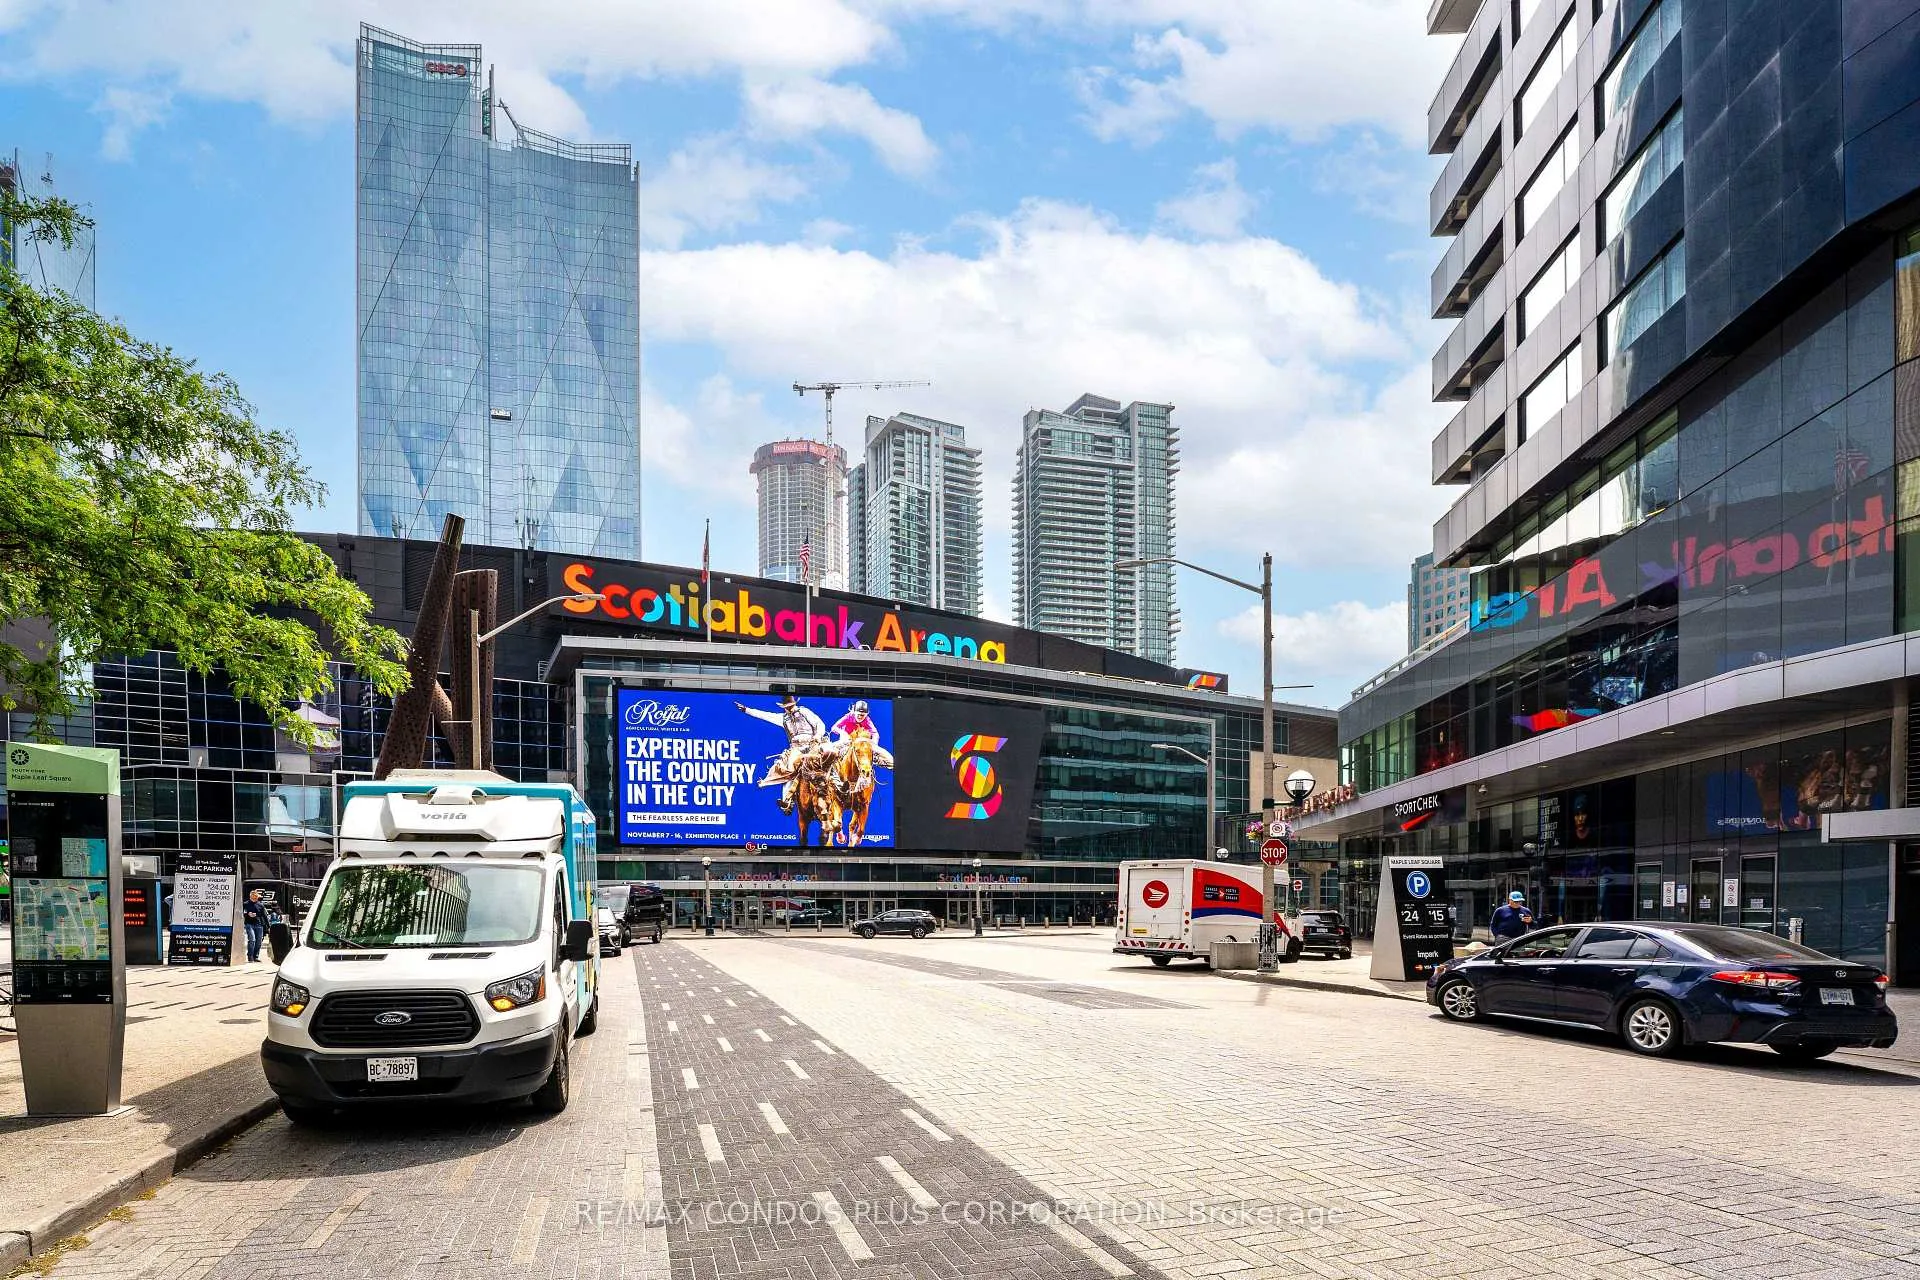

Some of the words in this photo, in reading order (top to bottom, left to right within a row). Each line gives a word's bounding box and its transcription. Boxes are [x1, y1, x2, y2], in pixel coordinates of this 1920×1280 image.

[562, 563, 865, 650] Scotiabank
[873, 611, 1006, 665] Arena
[625, 699, 690, 726] Royal
[626, 736, 740, 761] EXPERIENCE
[625, 760, 662, 782] THE
[667, 761, 757, 784] COUNTRY
[627, 783, 647, 805] IN
[652, 784, 689, 806] THE
[693, 785, 735, 807] CITY
[1394, 794, 1439, 816] SPORTCHEK
[1262, 847, 1286, 858] STOP
[180, 864, 202, 872] PUBLIC
[203, 865, 233, 873] PARKING
[998, 874, 1028, 883] Arena
[191, 910, 214, 918] $15.00
[1401, 910, 1420, 922] $24
[1417, 950, 1439, 959] impark
[381, 1014, 403, 1023] Ford
[369, 1064, 381, 1076] BC
[386, 1063, 415, 1075] 78897
